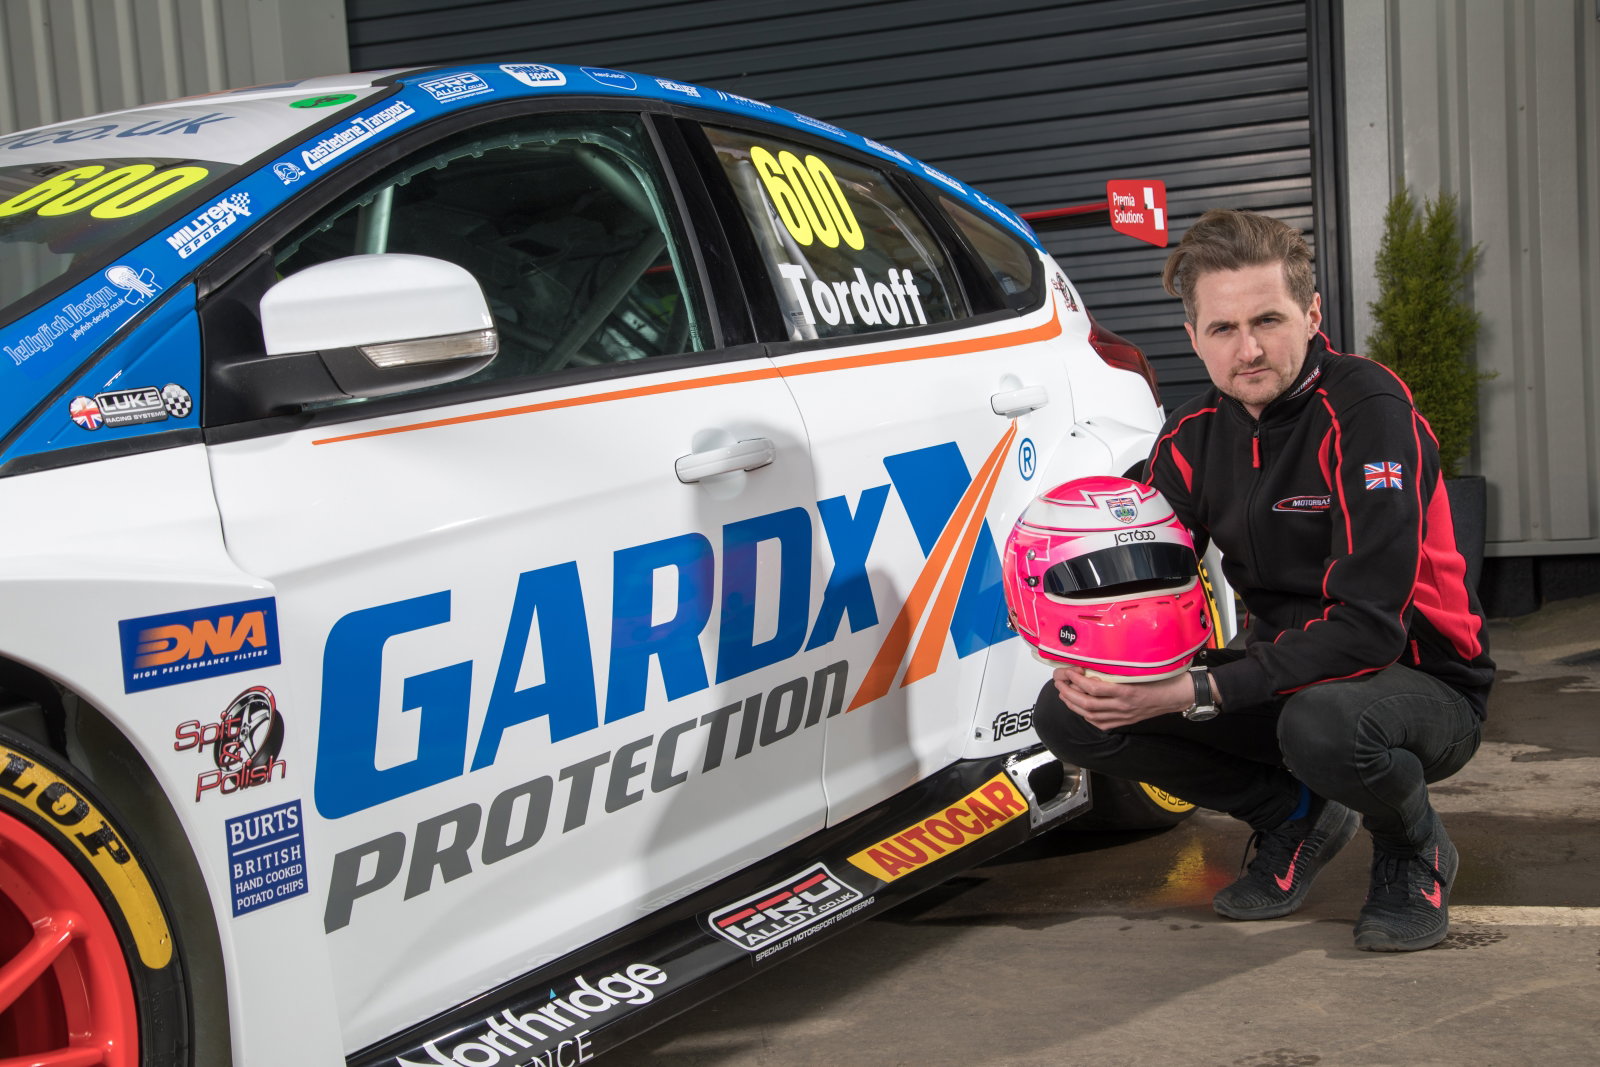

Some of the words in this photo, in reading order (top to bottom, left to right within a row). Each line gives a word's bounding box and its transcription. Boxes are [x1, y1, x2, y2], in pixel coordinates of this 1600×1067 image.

[351, 100, 413, 136] Transport
[0, 164, 209, 219] 600
[751, 146, 865, 250] 600
[1113, 192, 1136, 207] Premia
[1114, 209, 1144, 224] Solutions
[184, 217, 229, 255] SPORT
[778, 263, 928, 326] Tordoff
[4, 310, 75, 366] Jellyfish
[62, 286, 118, 322] Design
[100, 391, 160, 411] LUKE
[105, 415, 132, 423] RACING
[133, 410, 166, 420] SYSTEMS
[133, 611, 267, 669] DNA
[1060, 629, 1076, 642] bhp
[133, 670, 158, 680] HIGH
[162, 656, 230, 675] PERFORMANCE
[234, 649, 268, 661] FILTERS
[174, 711, 241, 753] Spit
[992, 704, 1036, 742] fas
[195, 755, 287, 803] Polish
[230, 806, 299, 846] BURTS
[867, 780, 1025, 877] AUTOCAR
[233, 844, 302, 879] BRITISH
[235, 876, 264, 895] HAND
[265, 863, 303, 884] COOKED
[237, 889, 274, 910] POTATO
[276, 879, 304, 897] CHIPS
[755, 937, 793, 961] SPECIALIST
[792, 917, 837, 944] MOTORSPORT
[836, 896, 875, 921] ENGINEERING
